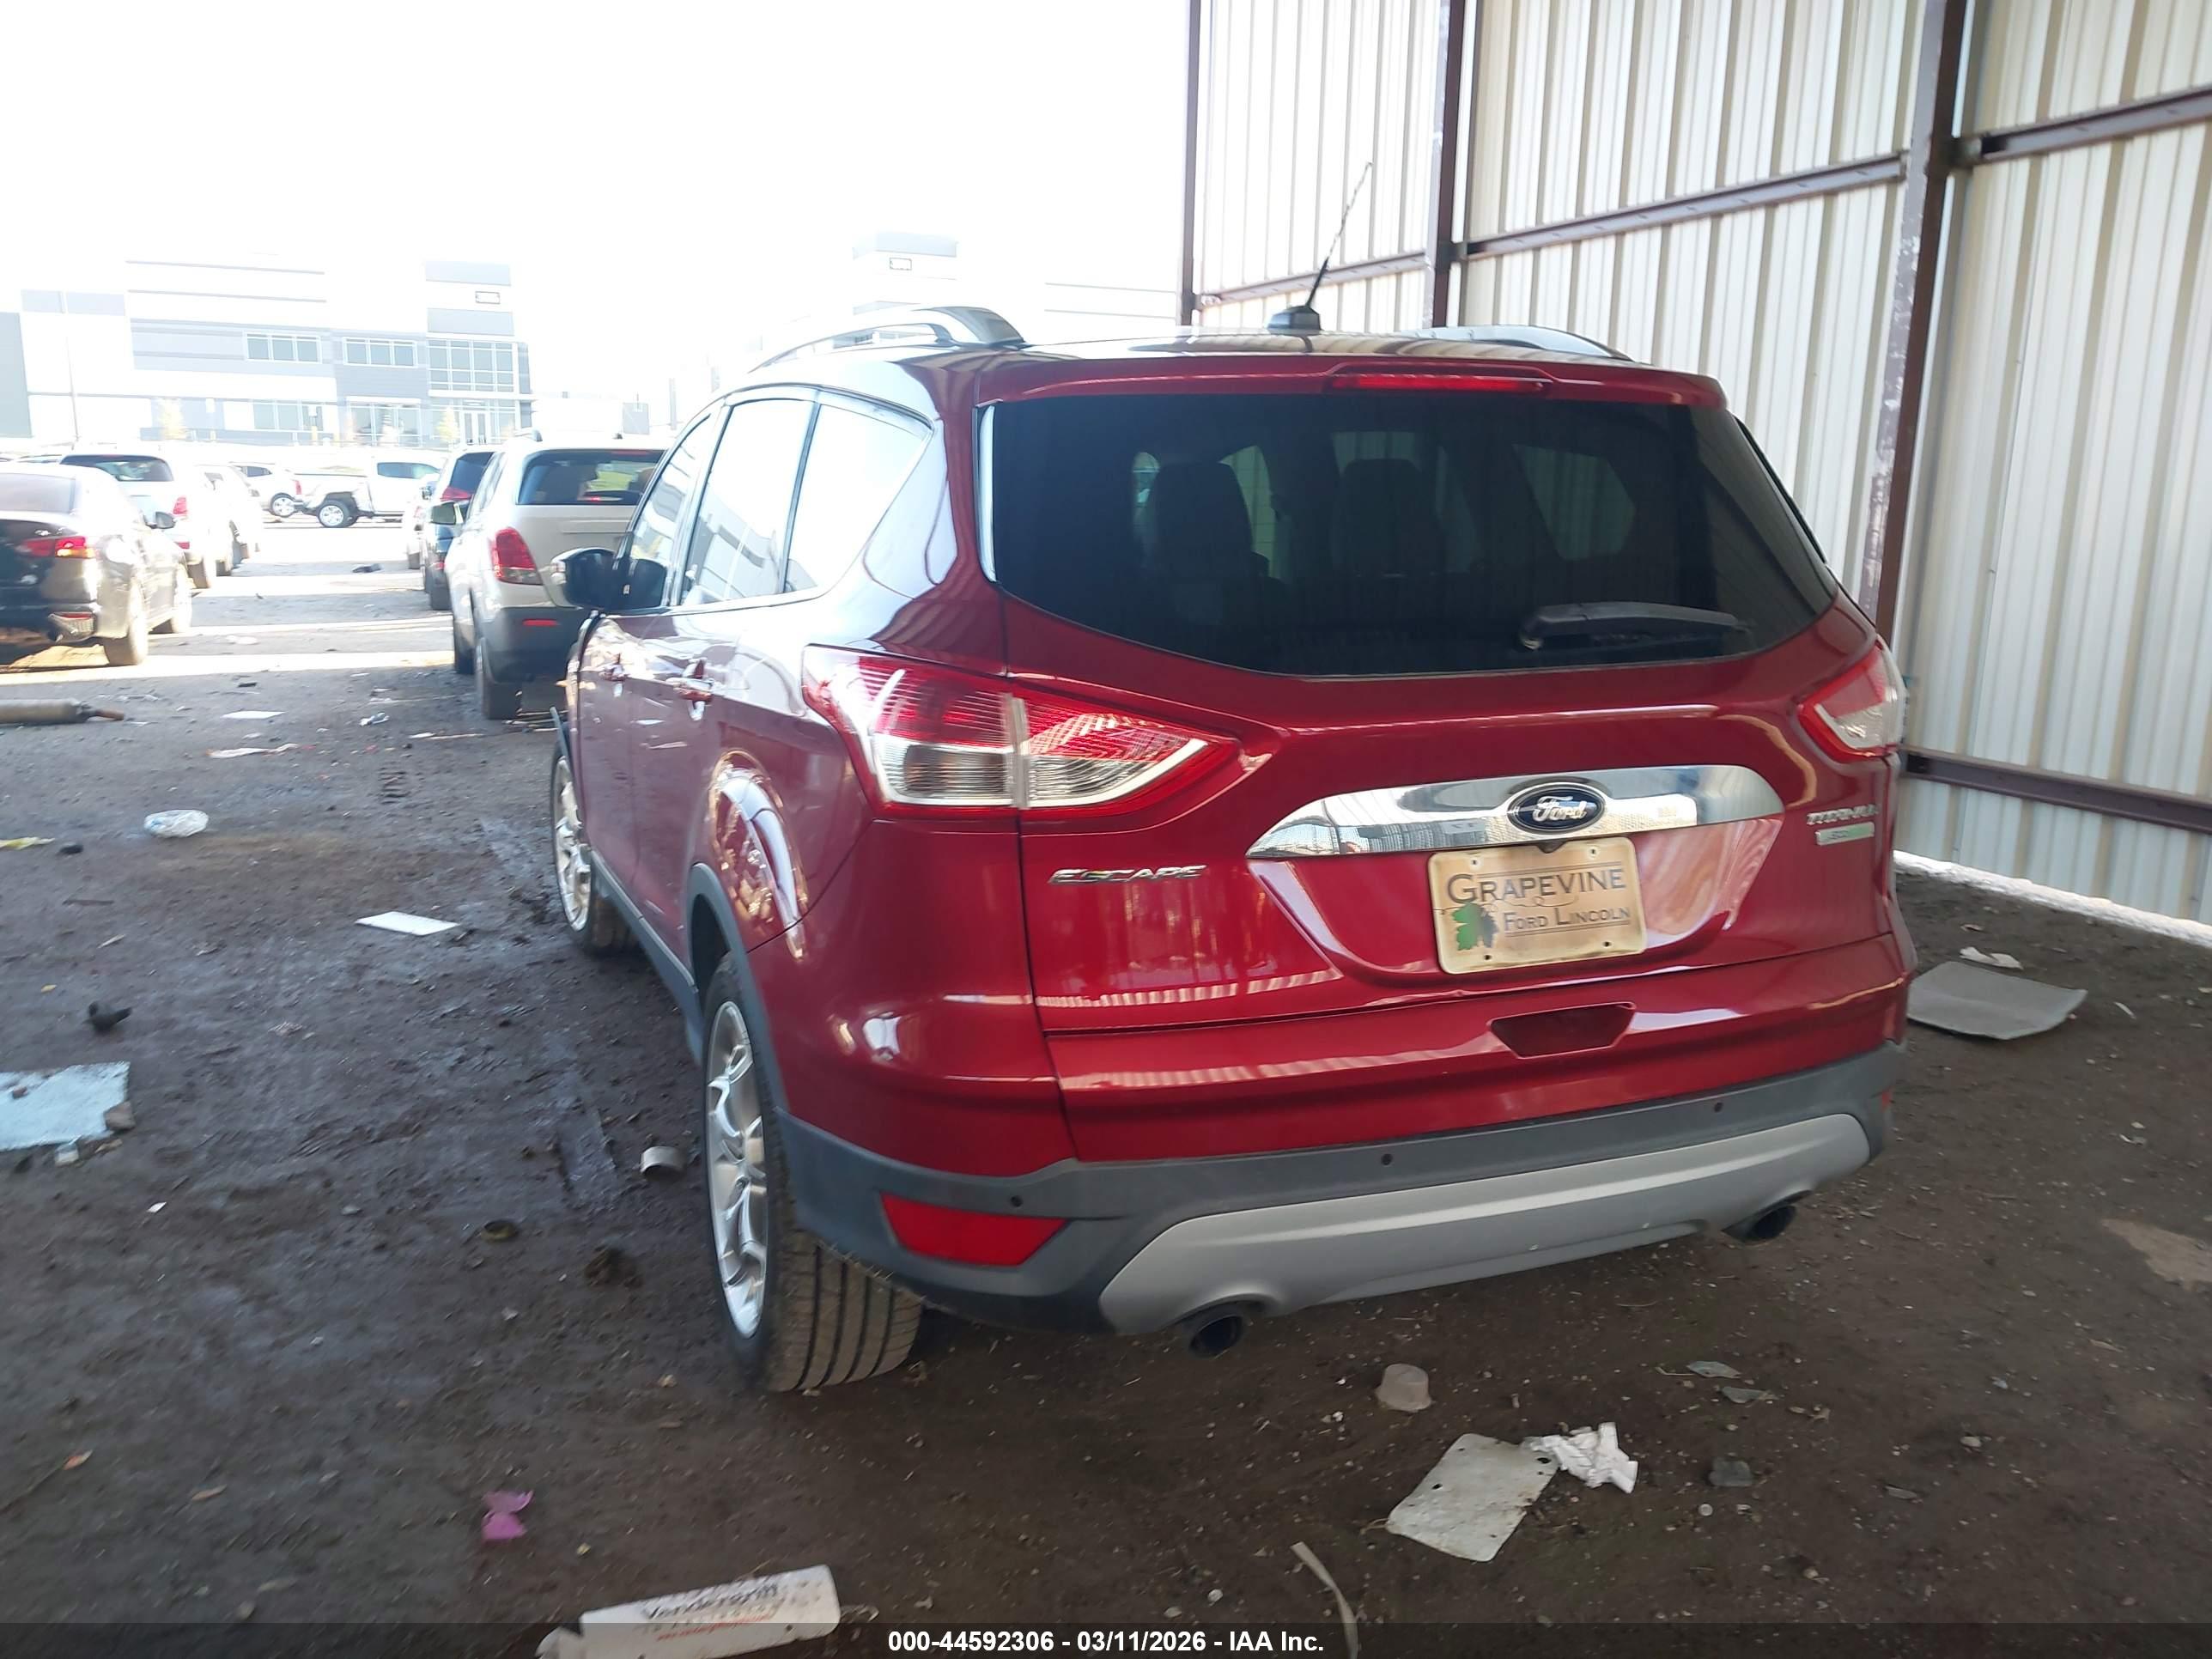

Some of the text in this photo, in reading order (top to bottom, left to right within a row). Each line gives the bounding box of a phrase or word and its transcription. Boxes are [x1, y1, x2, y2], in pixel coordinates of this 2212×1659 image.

[1532, 795, 1588, 823] Ford
[1048, 865, 1207, 886] ESCAPE
[1447, 868, 1626, 904] GRAPEVINE
[1504, 907, 1630, 932] FORD LINCOLN
